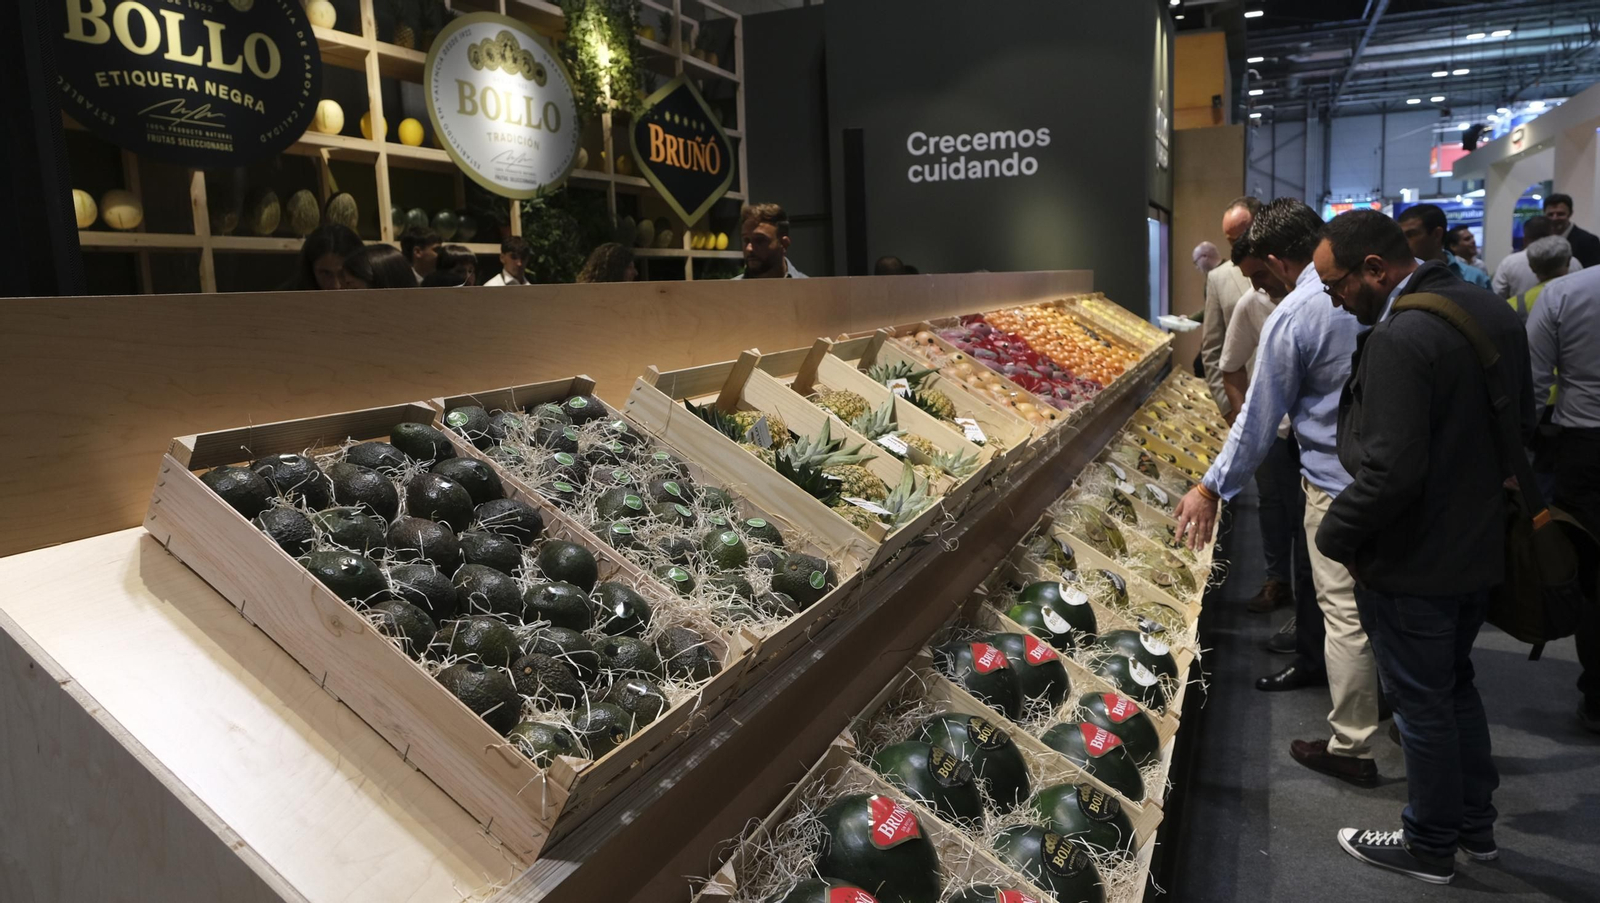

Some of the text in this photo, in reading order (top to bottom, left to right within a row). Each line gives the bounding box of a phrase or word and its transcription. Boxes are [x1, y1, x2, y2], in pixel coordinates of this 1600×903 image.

[63, 0, 282, 80] BOLLO
[95, 70, 266, 115] ETIQUETA NEGRA
[455, 78, 562, 133] BOLLO
[147, 133, 235, 152] FRUTAS SELECCIONADAS
[486, 132, 541, 151] TRADICIÓN
[907, 127, 1051, 156] Crecemos
[907, 151, 1039, 183] cuidando
